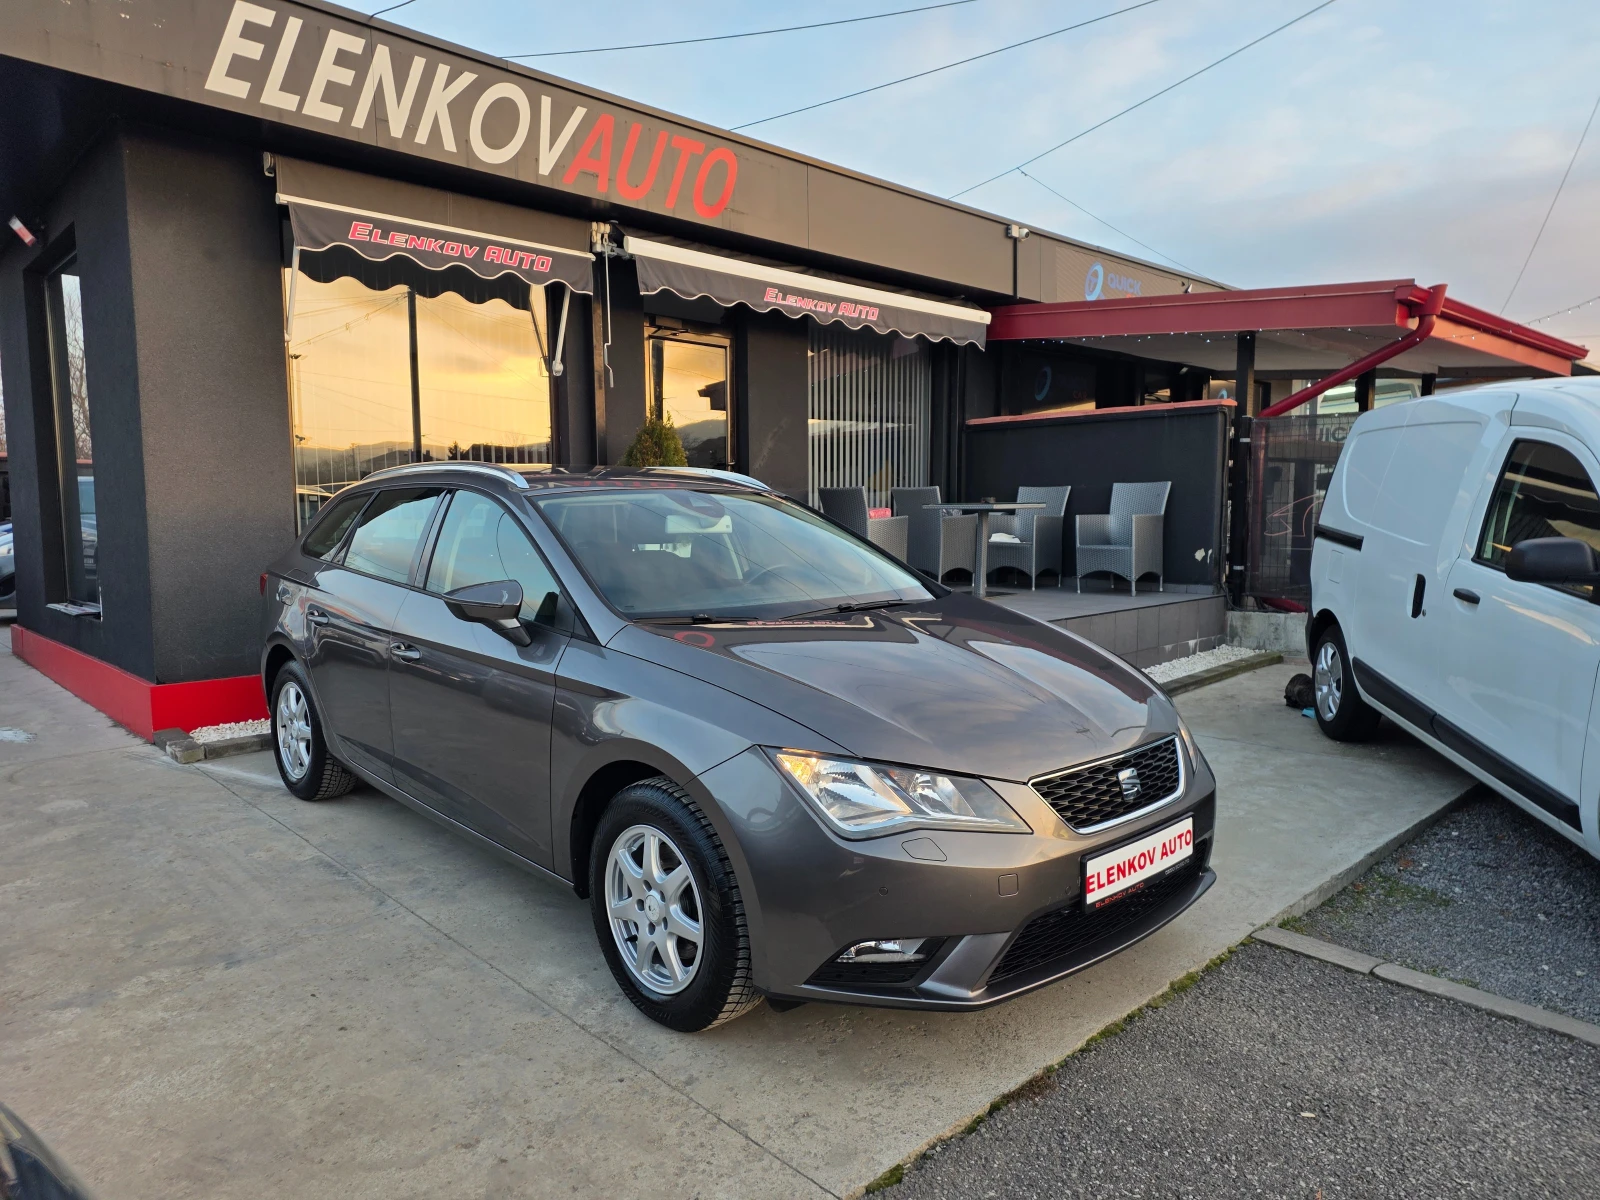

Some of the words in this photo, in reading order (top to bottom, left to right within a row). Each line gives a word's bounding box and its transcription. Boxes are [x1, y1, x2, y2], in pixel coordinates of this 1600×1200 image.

[348, 221, 480, 258] ELENKOV
[484, 245, 553, 272] AUTO
[764, 287, 837, 314] ELENKOV
[838, 301, 879, 320] AUTO
[1086, 846, 1156, 895] ELENKOV
[1160, 829, 1193, 861] AUTO
